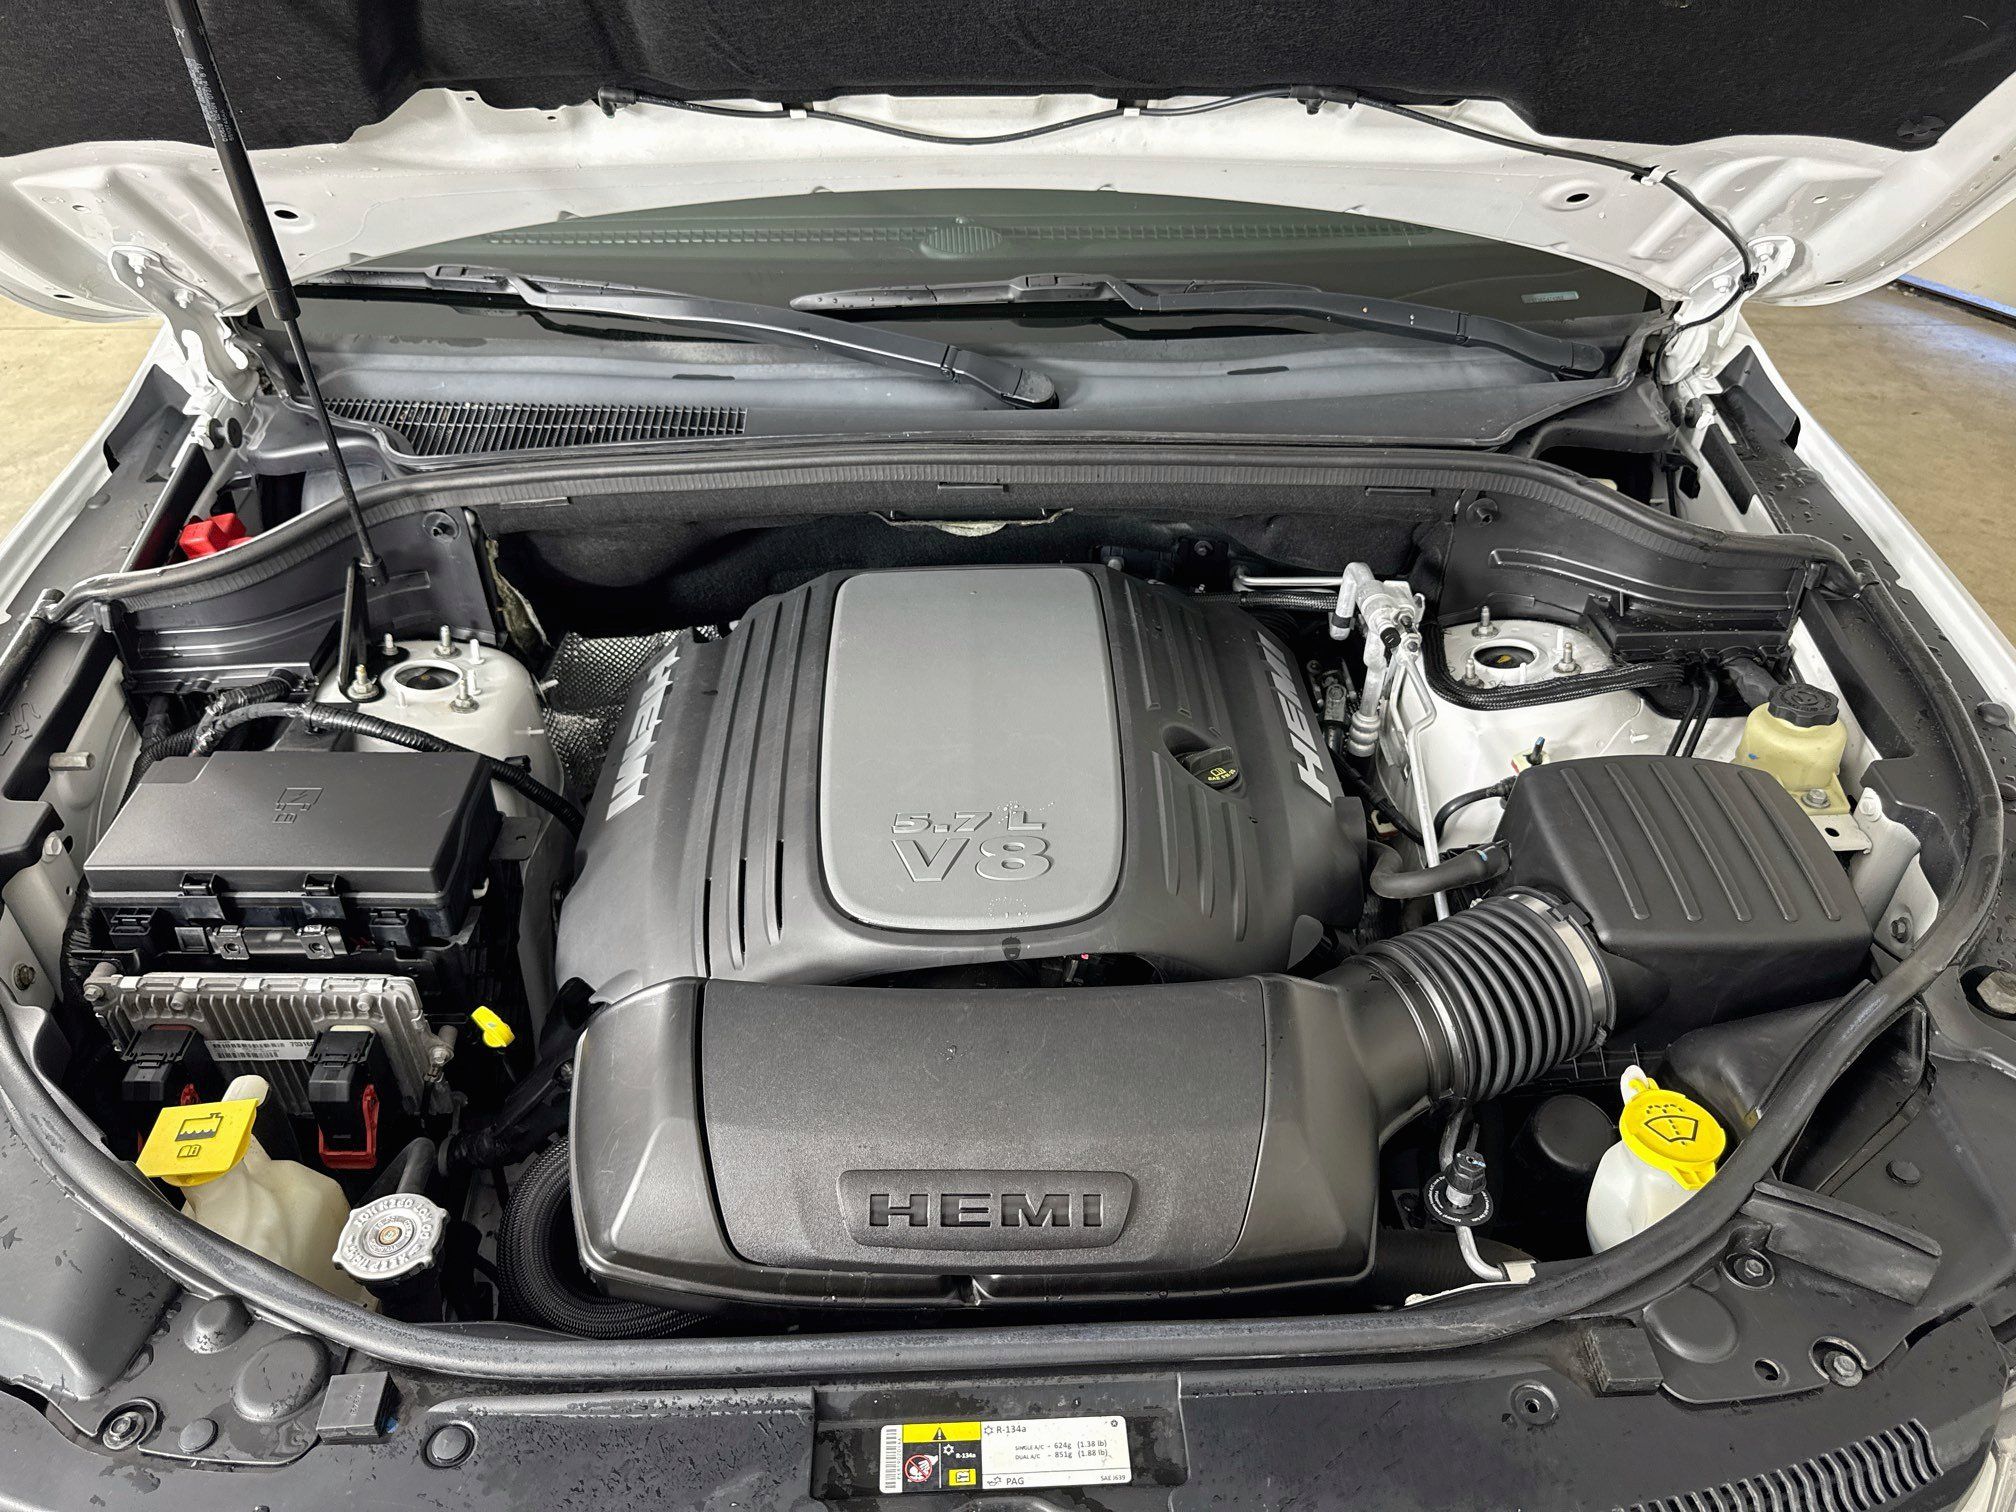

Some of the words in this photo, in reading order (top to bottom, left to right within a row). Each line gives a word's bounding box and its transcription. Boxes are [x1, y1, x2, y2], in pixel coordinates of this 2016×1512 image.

[1257, 630, 1332, 804] HEMI
[606, 646, 680, 821] HEMI
[892, 811, 992, 834] 5.7
[1007, 810, 1045, 831] L
[891, 835, 1054, 882] V8
[870, 1193, 1102, 1227] HEMI
[996, 1425, 1027, 1434] R-134a
[1053, 1442, 1072, 1450] 624g
[1077, 1440, 1096, 1449] (1.38
[1097, 1439, 1107, 1448] lb)
[1054, 1450, 1073, 1459] 851g
[1077, 1449, 1097, 1459] (1.88
[1098, 1448, 1108, 1457] lb)
[1006, 1476, 1025, 1486] PAG
